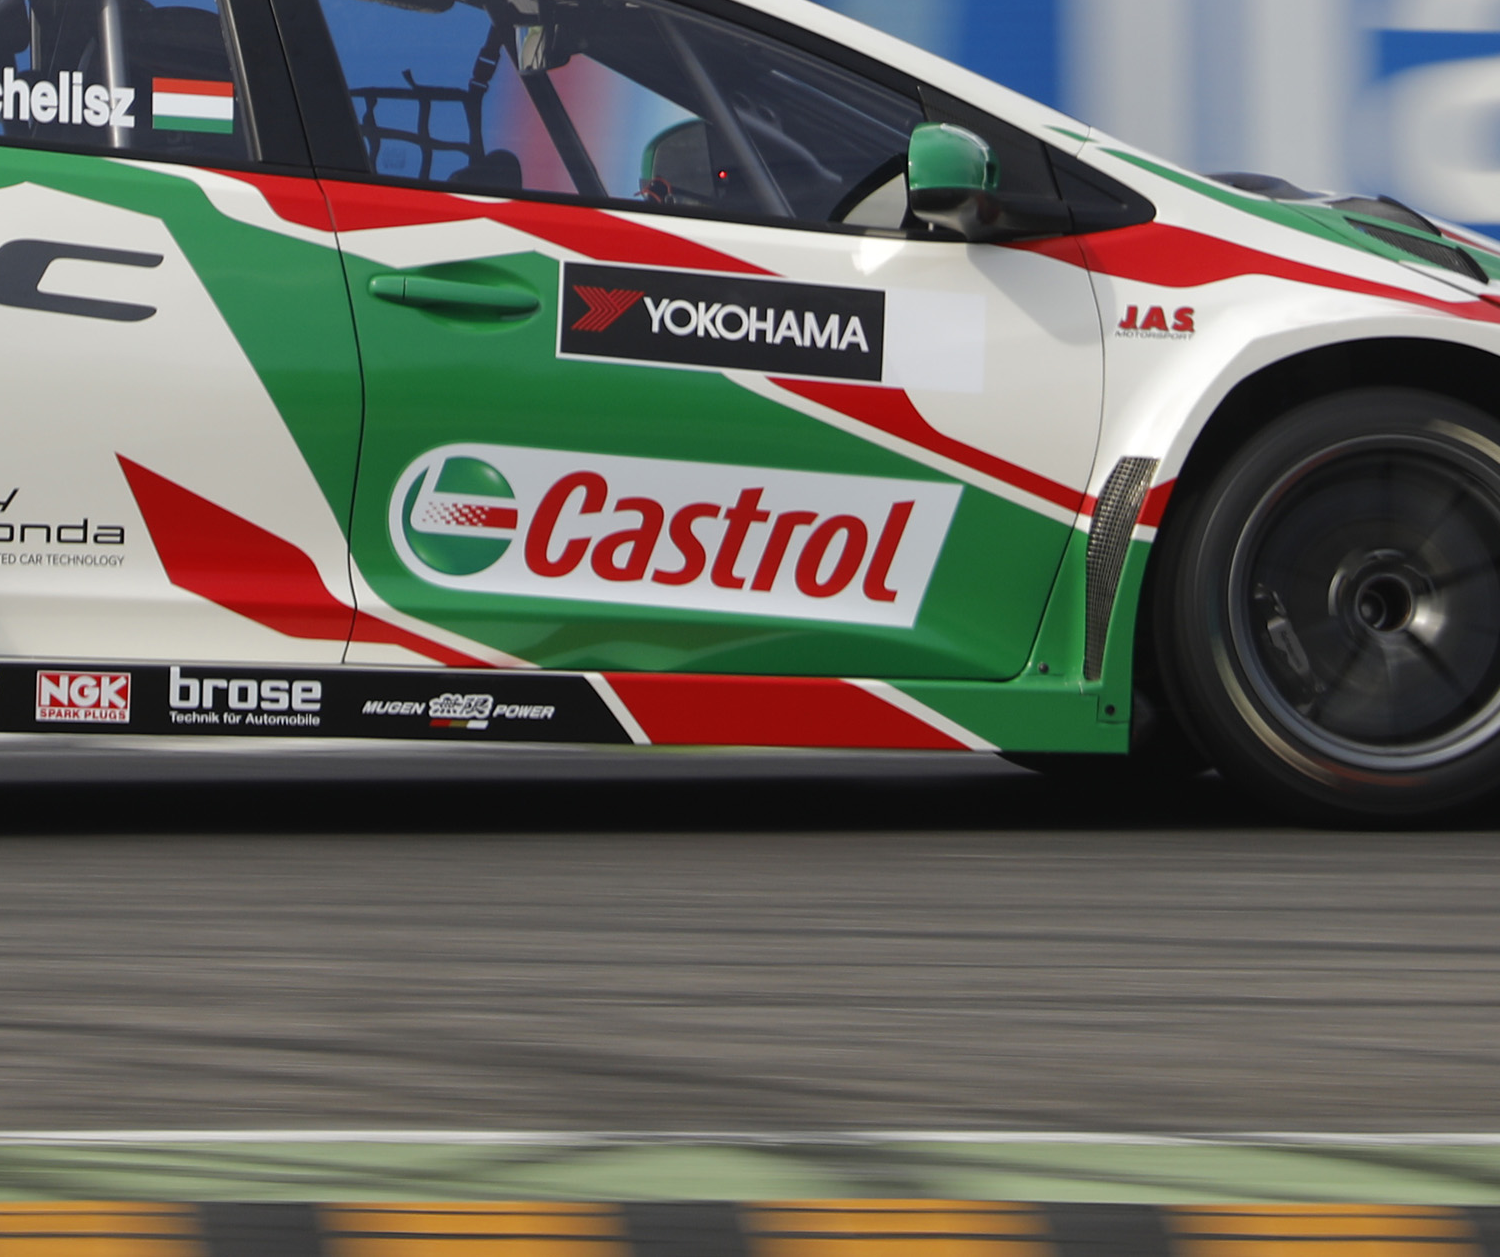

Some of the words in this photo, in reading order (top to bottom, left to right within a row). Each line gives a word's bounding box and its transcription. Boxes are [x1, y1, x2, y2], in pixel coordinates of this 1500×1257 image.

[643, 296, 869, 353] YOKOHAMA
[1118, 305, 1195, 333] JAS
[523, 471, 915, 604] Castrol
[19, 553, 43, 565] CAR
[46, 554, 125, 567] TECHNOLOGY
[40, 675, 127, 708] NGK
[169, 666, 322, 711] brose
[40, 708, 80, 720] SPARK
[84, 709, 127, 721] PLUGS
[169, 711, 220, 725] Technik
[222, 711, 242, 725] für
[245, 712, 321, 727] Automobile
[362, 700, 427, 716] MUGEN
[492, 704, 556, 719] POWER
